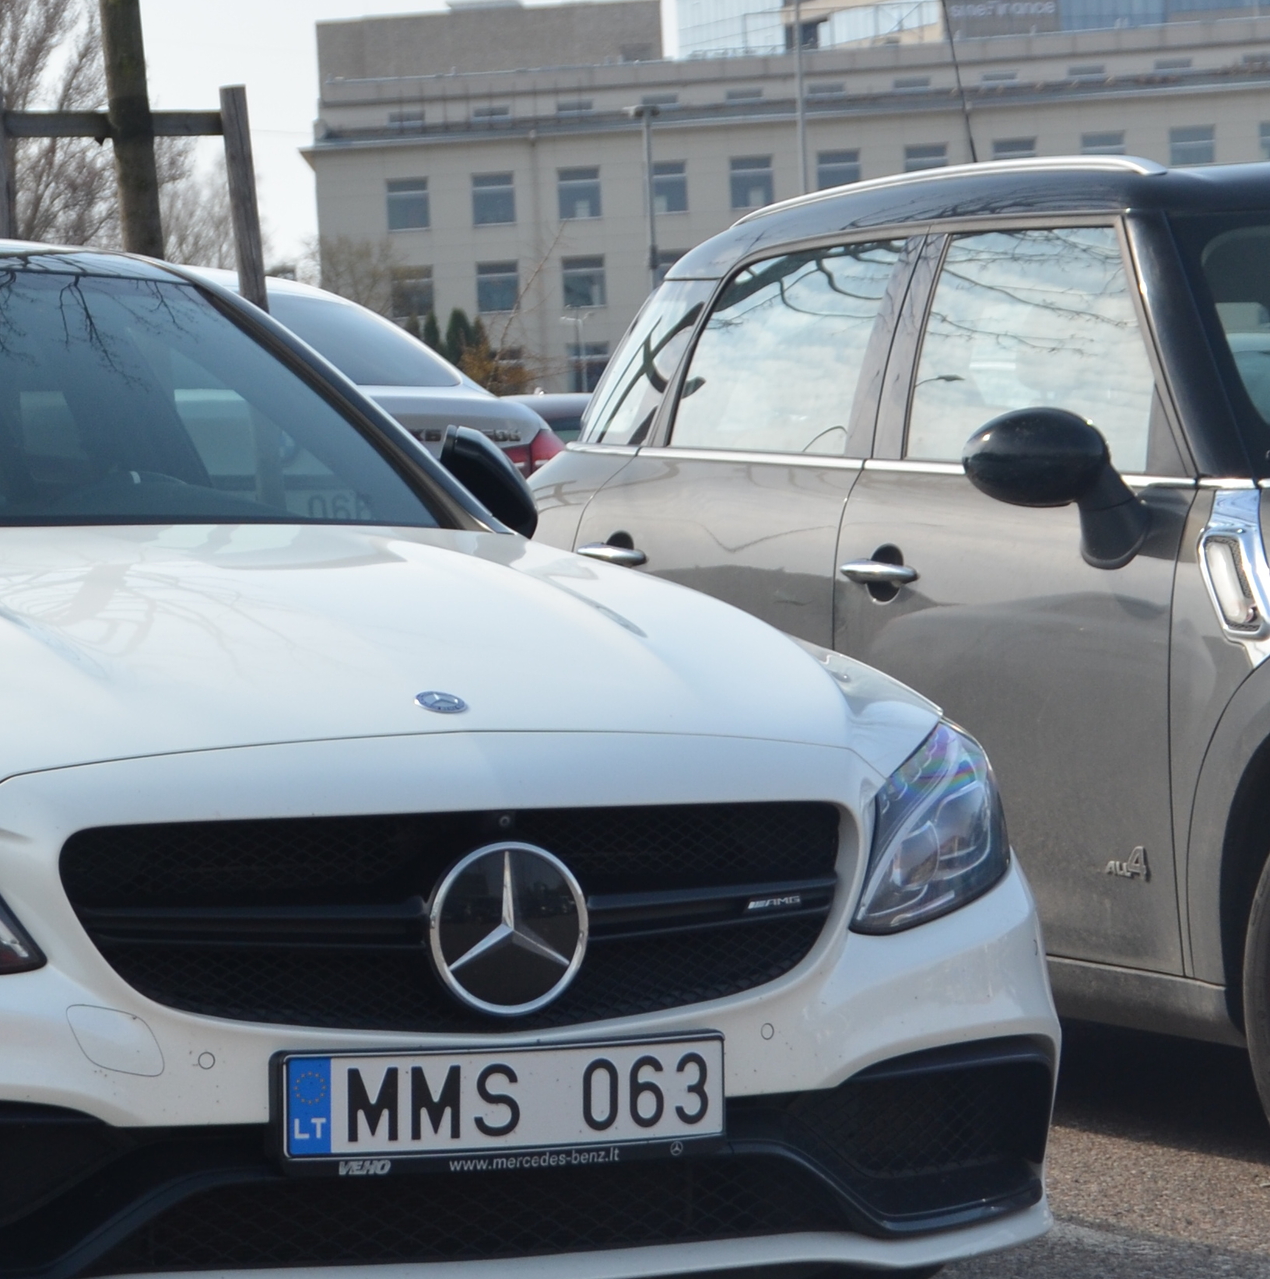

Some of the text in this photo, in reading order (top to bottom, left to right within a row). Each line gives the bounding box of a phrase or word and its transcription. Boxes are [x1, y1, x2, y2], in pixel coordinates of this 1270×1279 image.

[347, 1052, 709, 1142] MMS 063
[294, 1117, 327, 1139] LT
[338, 1159, 391, 1176] VEHO
[449, 1147, 619, 1172] www.mercedes-benz.lt
